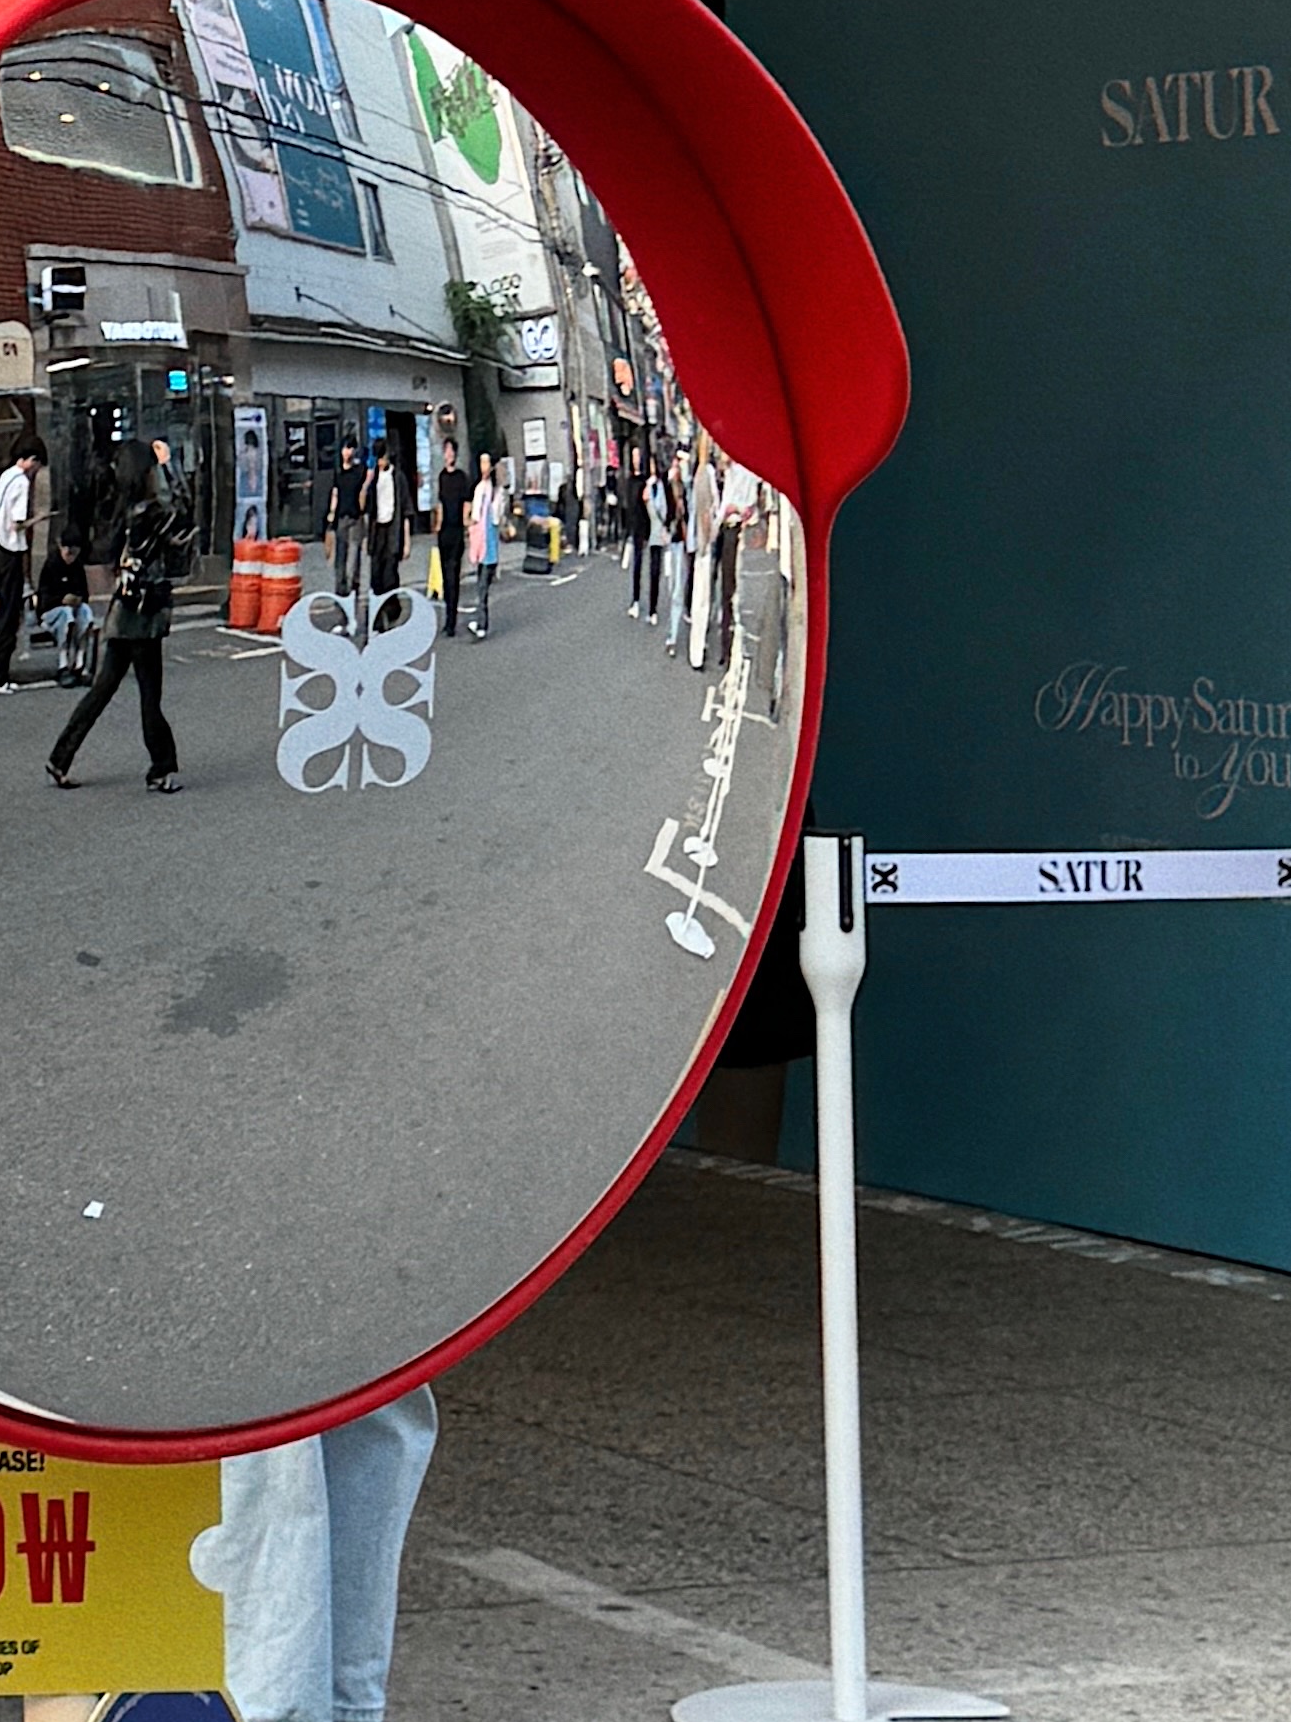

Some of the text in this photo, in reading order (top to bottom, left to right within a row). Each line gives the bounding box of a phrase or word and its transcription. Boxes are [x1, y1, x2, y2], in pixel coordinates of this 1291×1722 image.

[1101, 65, 1281, 148] SATUR
[1039, 859, 1144, 893] SATUR
[21, 1639, 40, 1654] OF
